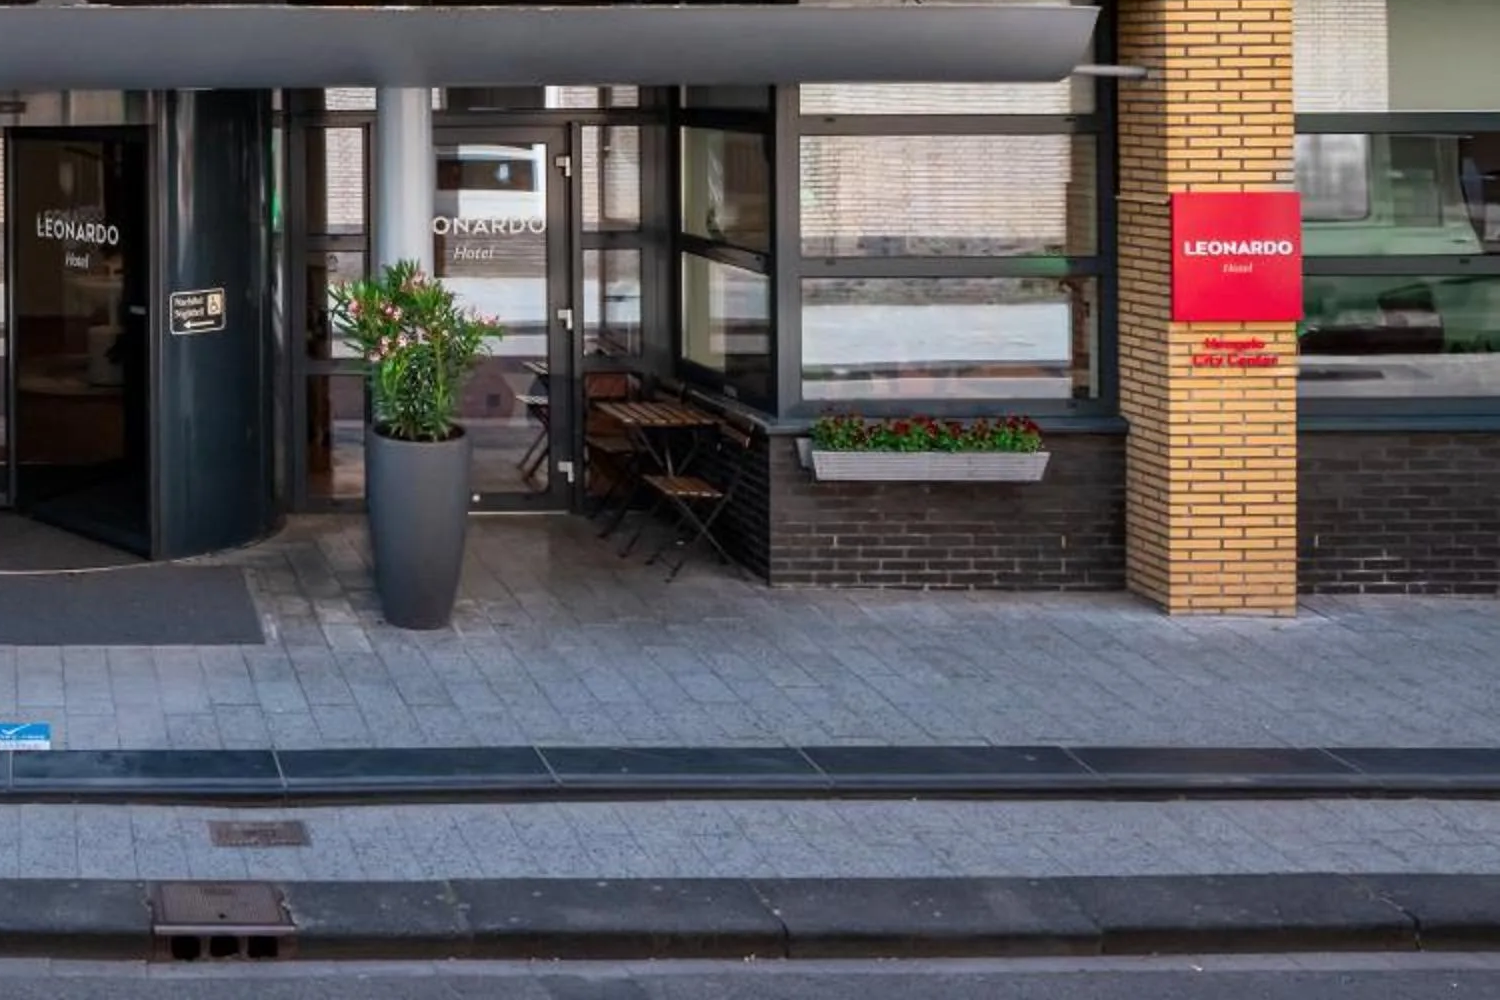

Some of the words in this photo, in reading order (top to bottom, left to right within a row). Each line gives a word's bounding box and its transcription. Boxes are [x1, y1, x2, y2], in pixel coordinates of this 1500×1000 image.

[36, 217, 119, 245] LEONARDO
[433, 216, 546, 235] ONARDO
[453, 246, 496, 260] Hotel
[1183, 240, 1294, 256] LEONARDO
